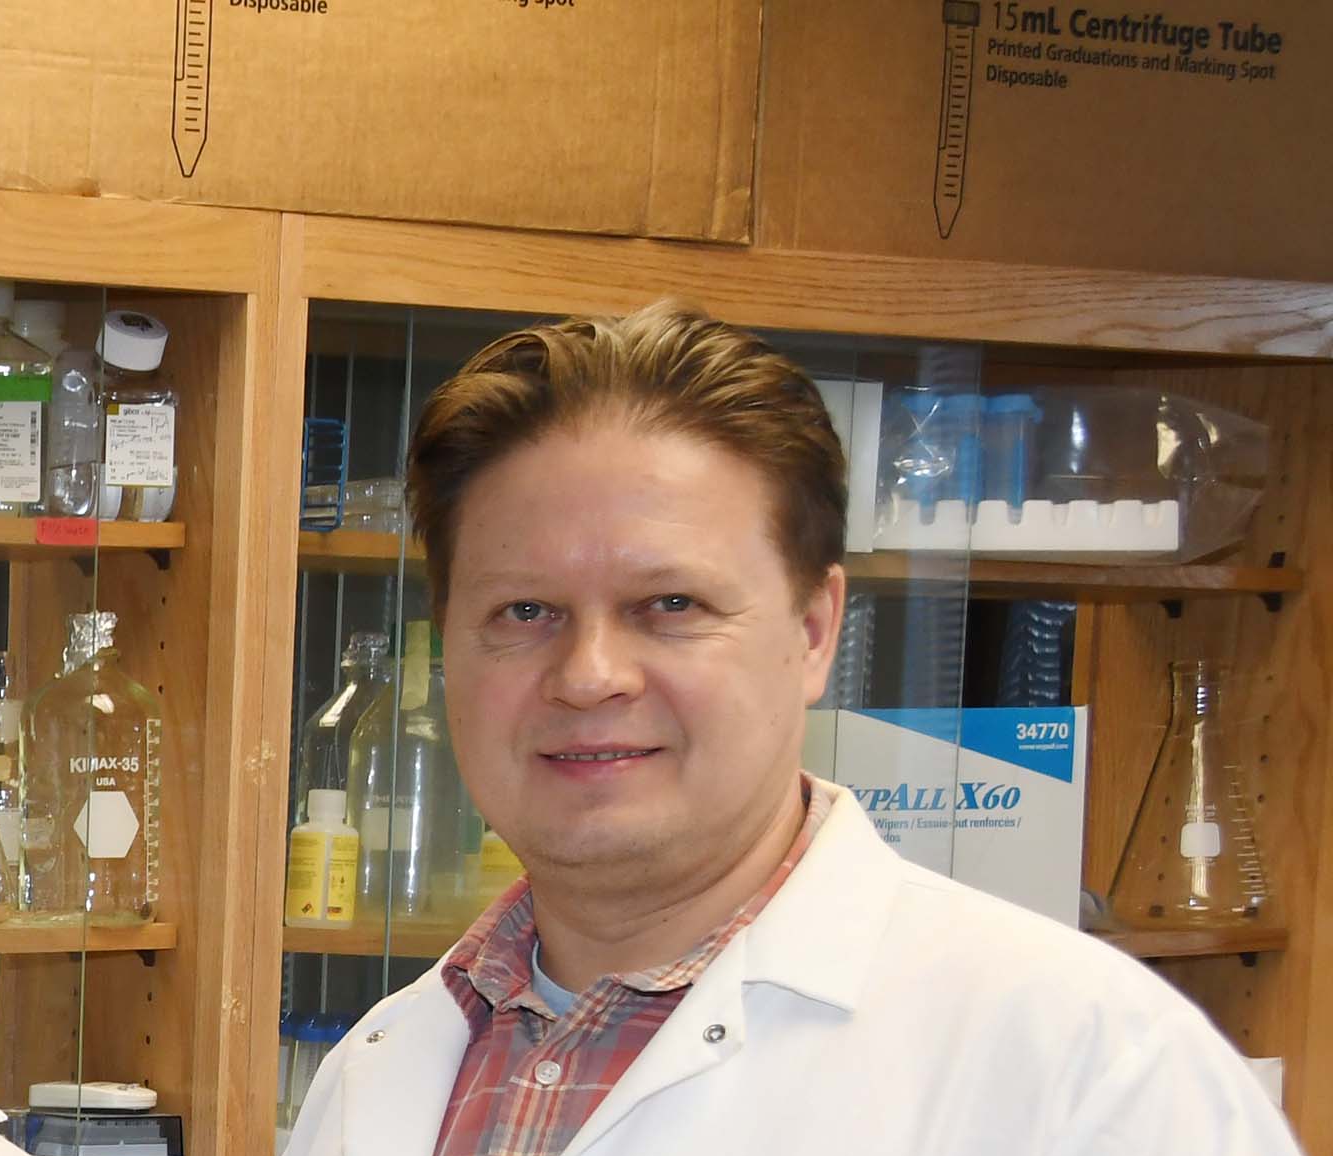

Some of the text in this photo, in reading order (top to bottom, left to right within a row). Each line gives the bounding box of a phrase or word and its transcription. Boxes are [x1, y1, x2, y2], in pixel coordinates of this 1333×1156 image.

[1069, 9, 1210, 54] Centrifuge
[1217, 21, 1282, 54] Tube
[987, 38, 1277, 83] Printed Graduations and Marking Spot
[985, 64, 1069, 89] Disposable
[1016, 722, 1069, 741] 34770
[96, 777, 116, 787] USA
[848, 782, 1022, 812] YPALL X60
[873, 818, 909, 832] Wipers
[917, 816, 968, 829] Essuie-out
